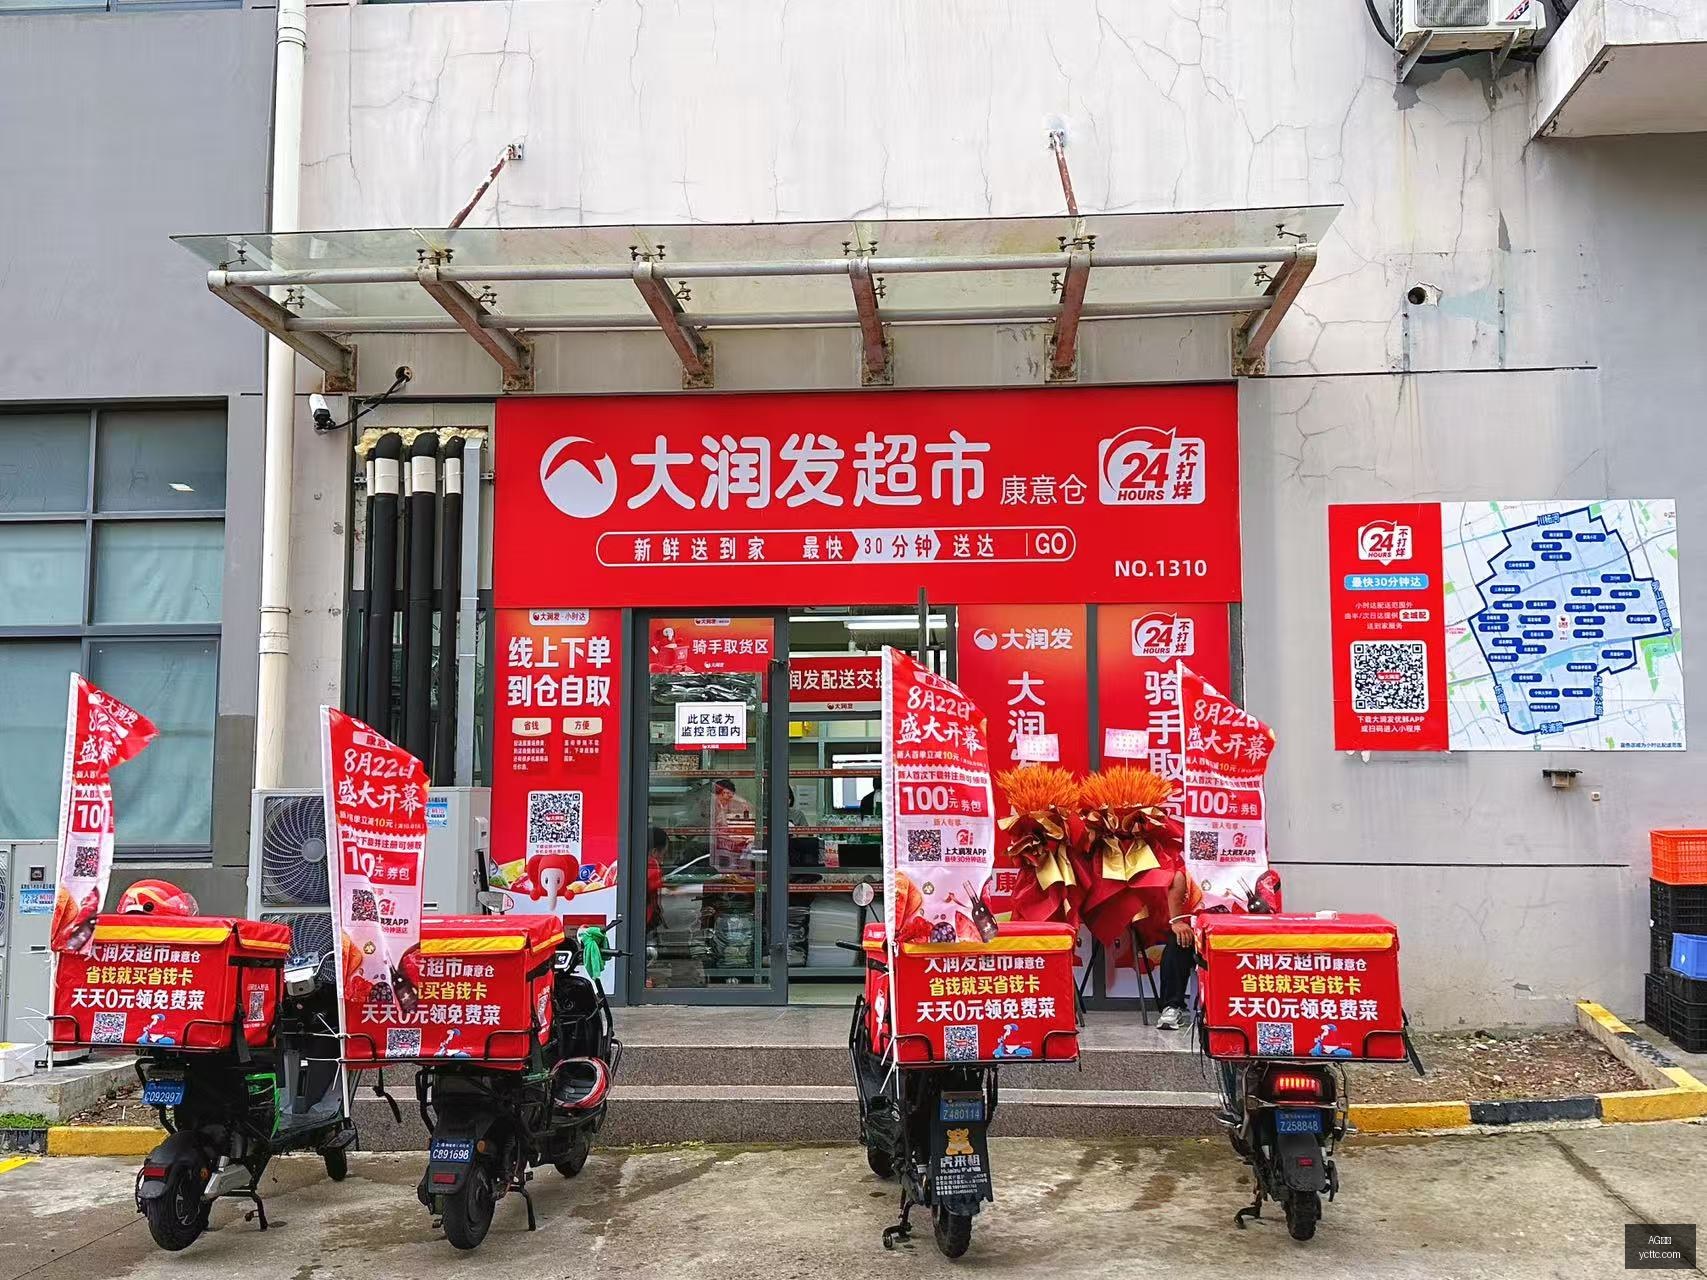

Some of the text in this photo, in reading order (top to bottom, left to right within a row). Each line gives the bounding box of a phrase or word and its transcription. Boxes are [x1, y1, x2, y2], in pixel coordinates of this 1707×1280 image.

[627, 430, 1088, 510] 大润发超市 康意仓
[1119, 452, 1169, 489] 24
[1171, 443, 1199, 500] 不打烊
[1117, 489, 1165, 501] HOURS
[634, 536, 765, 562] 新鲜送到家
[1035, 532, 1067, 555] GO
[1369, 533, 1394, 552] 24
[1395, 528, 1409, 557] 不打烊
[1114, 559, 1208, 577] NO.1310
[1351, 576, 1422, 588] 最快30分钟达
[692, 639, 769, 655] 骑手取货区
[1001, 628, 1073, 650] 大润发
[1144, 626, 1173, 647] 24
[1175, 621, 1190, 653] 不打烊
[508, 636, 612, 669] 线上下单
[507, 674, 611, 707] 到仓自取
[105, 699, 139, 728] 大润发
[907, 685, 971, 721] 8月22日
[523, 720, 590, 731] 省钱 方便
[687, 713, 735, 725] 此区域为
[681, 726, 741, 737] 监控范围内
[895, 712, 985, 758] 盛大开幕
[1186, 722, 1269, 766] 盛大开幕
[344, 748, 415, 779] 8月22日
[336, 774, 423, 820] 盛大开幕
[961, 799, 982, 813] 券包
[1240, 802, 1258, 816] 券包
[944, 847, 987, 856] 上大润发APP
[387, 866, 410, 881] 券包
[85, 966, 194, 986] 省钱就买省钱卡
[929, 974, 1041, 997] 省钱就买省钱卡
[1241, 973, 1362, 996] 省钱就买省钱卡
[70, 987, 206, 1011] 天天0元领免费菜
[916, 997, 1056, 1023] 天天0元领免费菜
[1228, 996, 1379, 1021] 天天0元领免费菜
[144, 1091, 181, 1103] C092997
[943, 1109, 980, 1120] Z480114
[1280, 1120, 1319, 1132] Z258848
[432, 1149, 469, 1160] C891698
